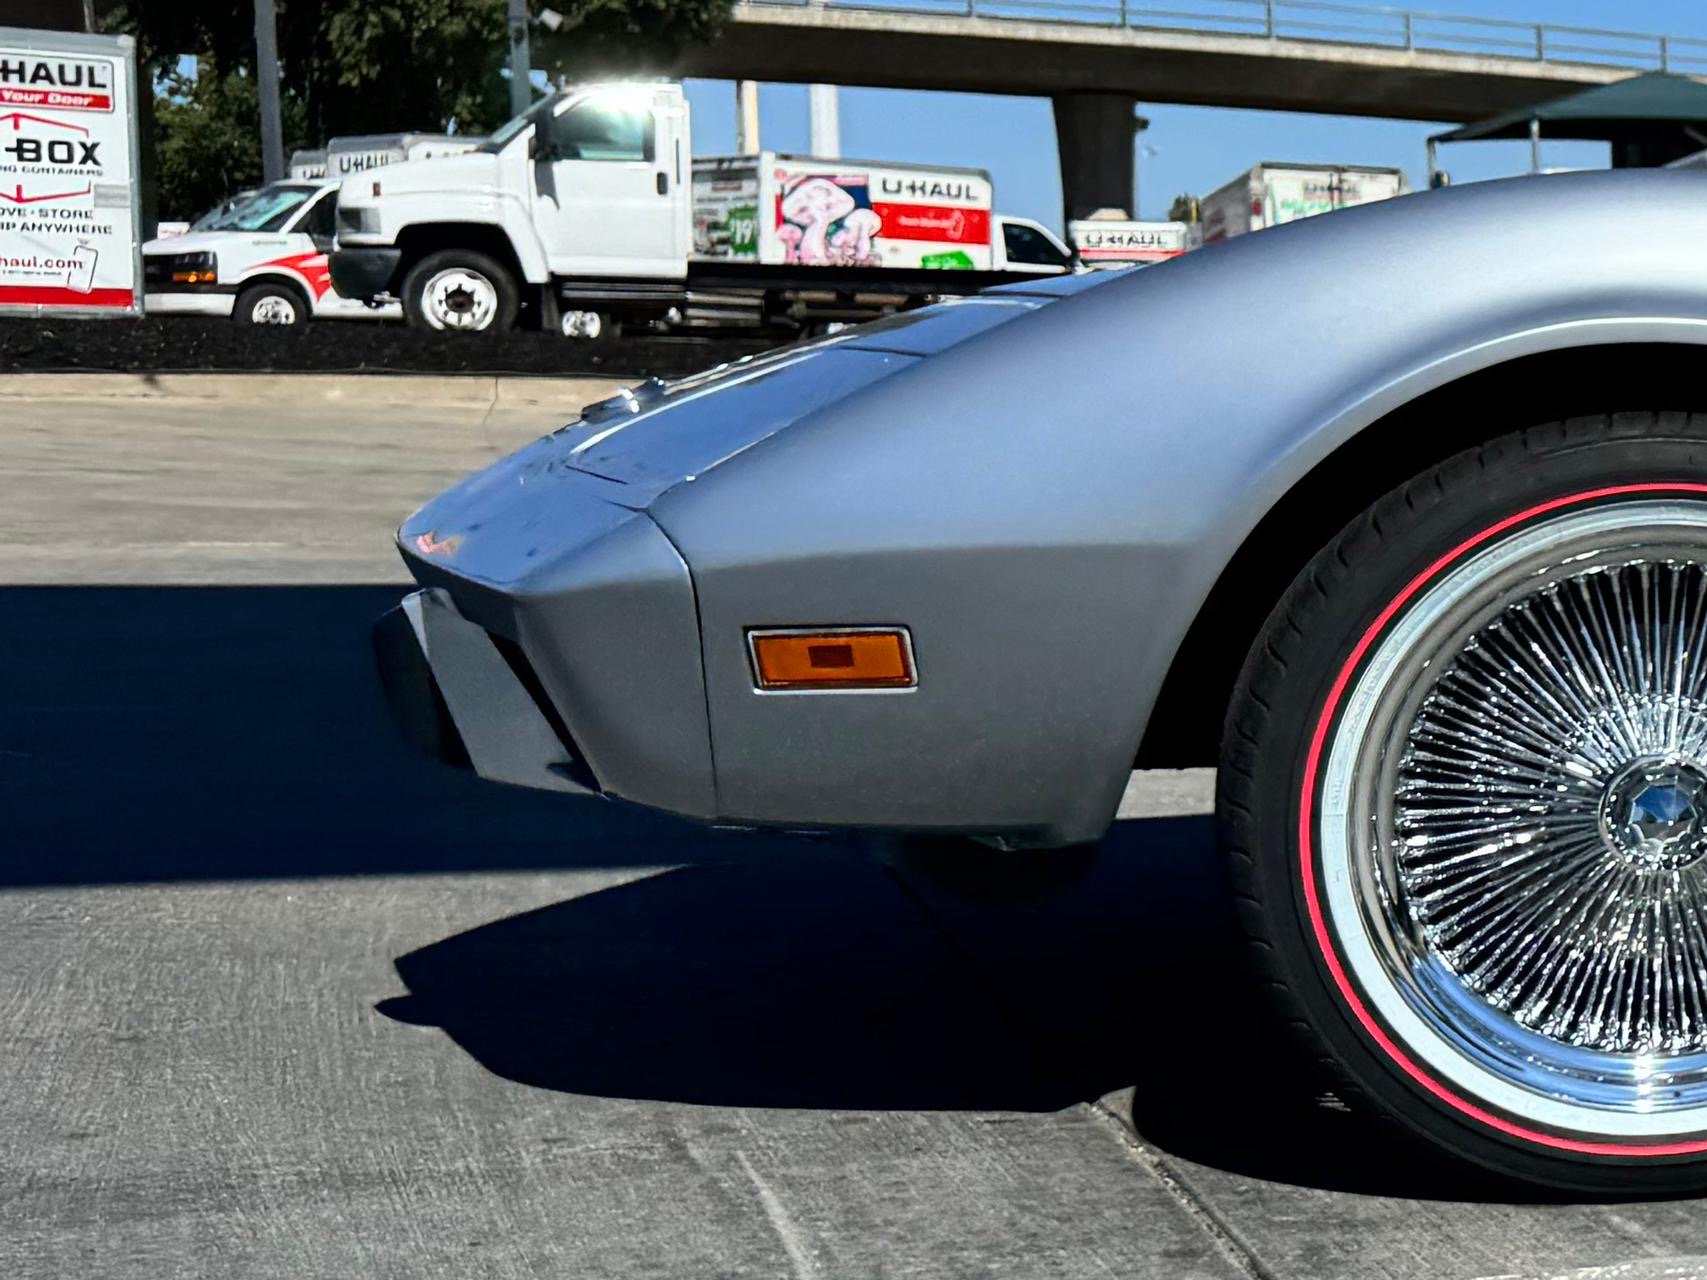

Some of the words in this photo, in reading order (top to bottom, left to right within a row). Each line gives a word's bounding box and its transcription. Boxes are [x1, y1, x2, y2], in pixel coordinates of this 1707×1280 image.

[2, 90, 44, 103] Your
[48, 93, 94, 106] Door
[38, 208, 94, 220] STORE
[21, 222, 112, 235] ANYWHERE
